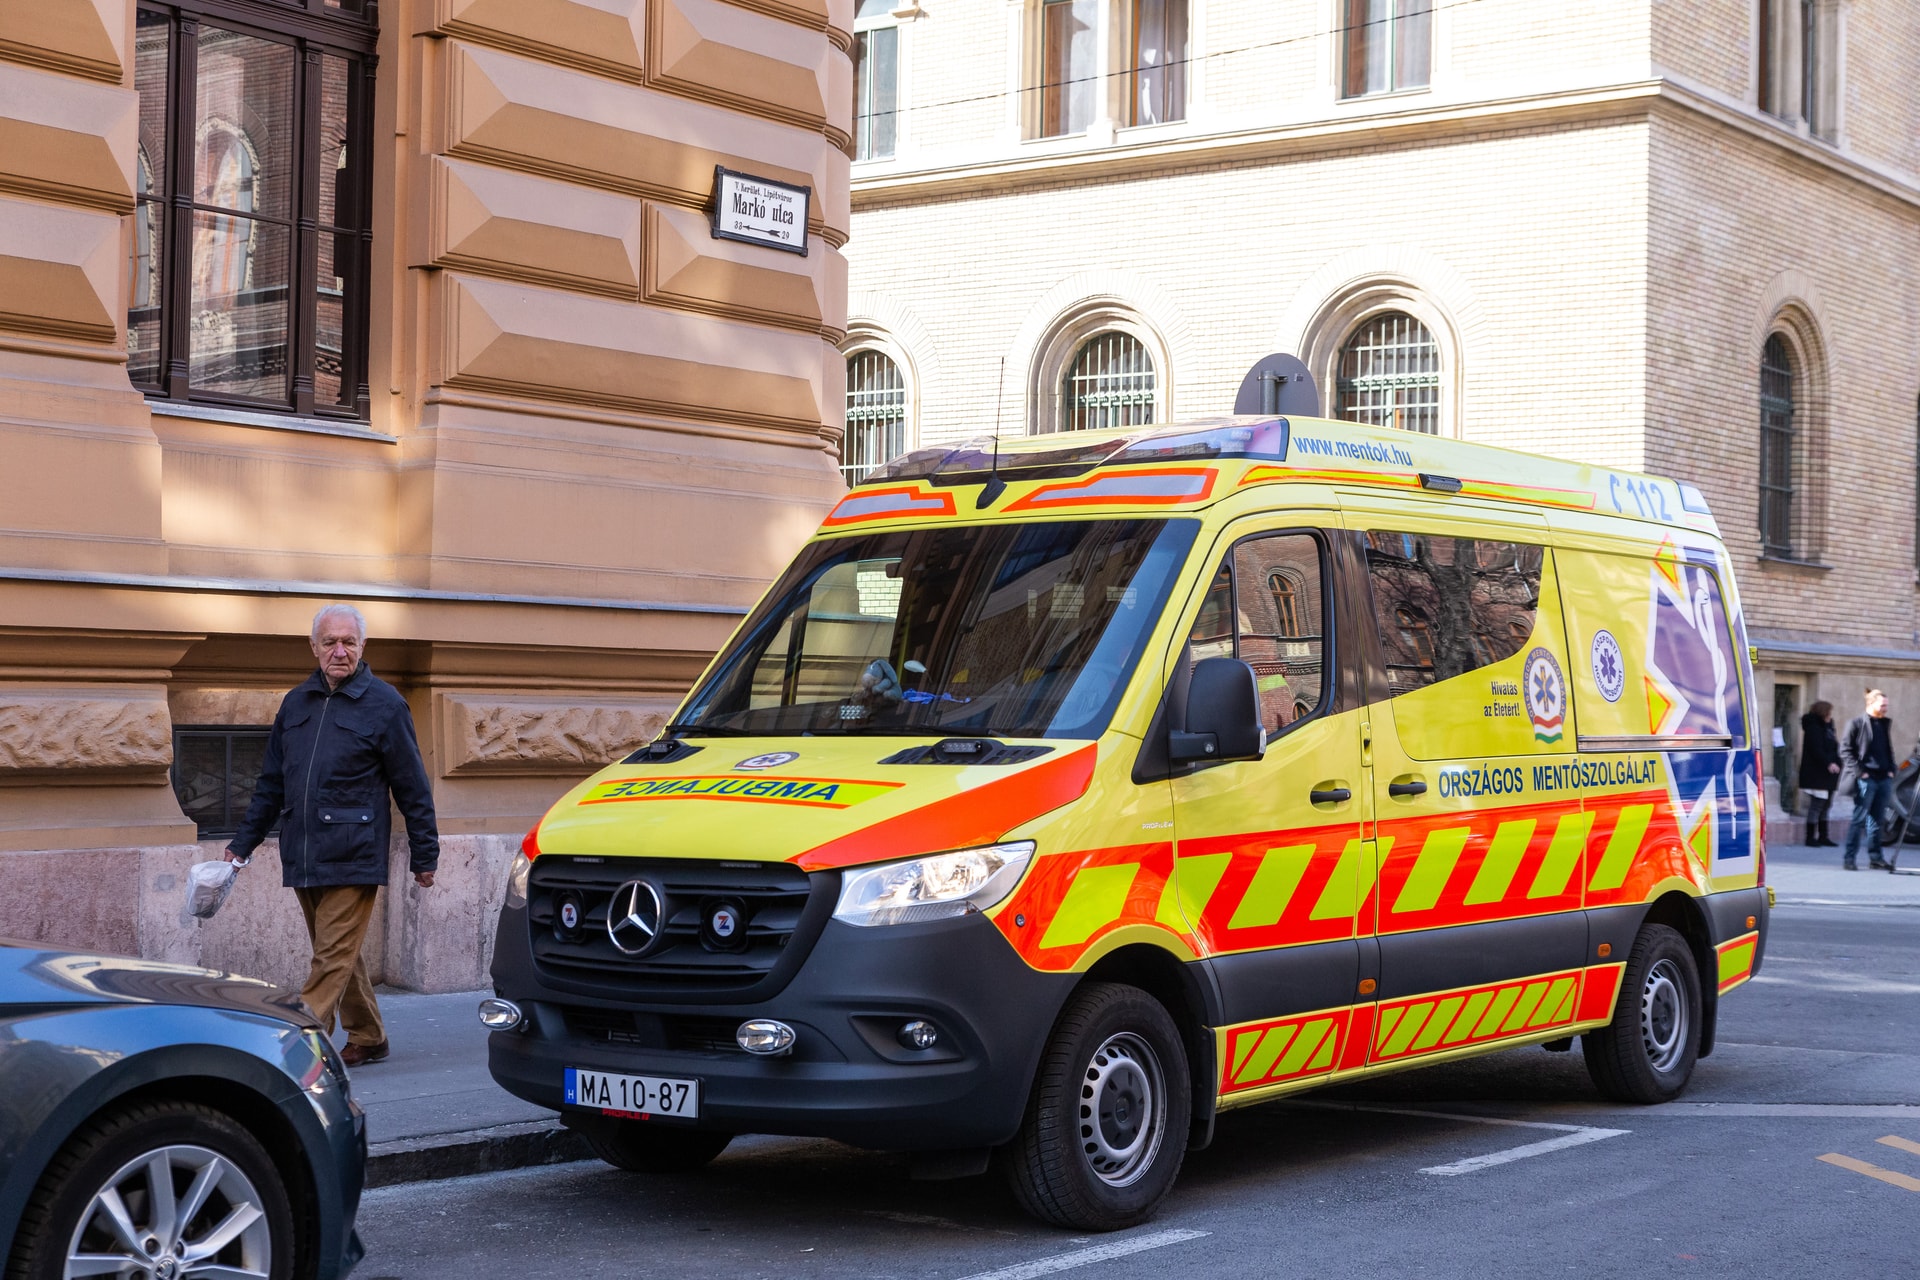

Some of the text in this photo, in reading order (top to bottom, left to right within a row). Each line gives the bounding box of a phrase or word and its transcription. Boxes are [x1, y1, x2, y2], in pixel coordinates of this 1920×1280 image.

[732, 192, 794, 225] Markó utca
[764, 188, 793, 203] Lipótváros
[1293, 437, 1413, 466] www.mentok.hu
[1626, 478, 1673, 521] 112
[1491, 681, 1518, 695] Hivatás
[1484, 699, 1520, 717] az Életért!
[1439, 756, 1656, 798] ORSZÁGOS MENTŐSZOLGÁLAT
[568, 1089, 574, 1100] H
[581, 1074, 690, 1113] MA 10-87
